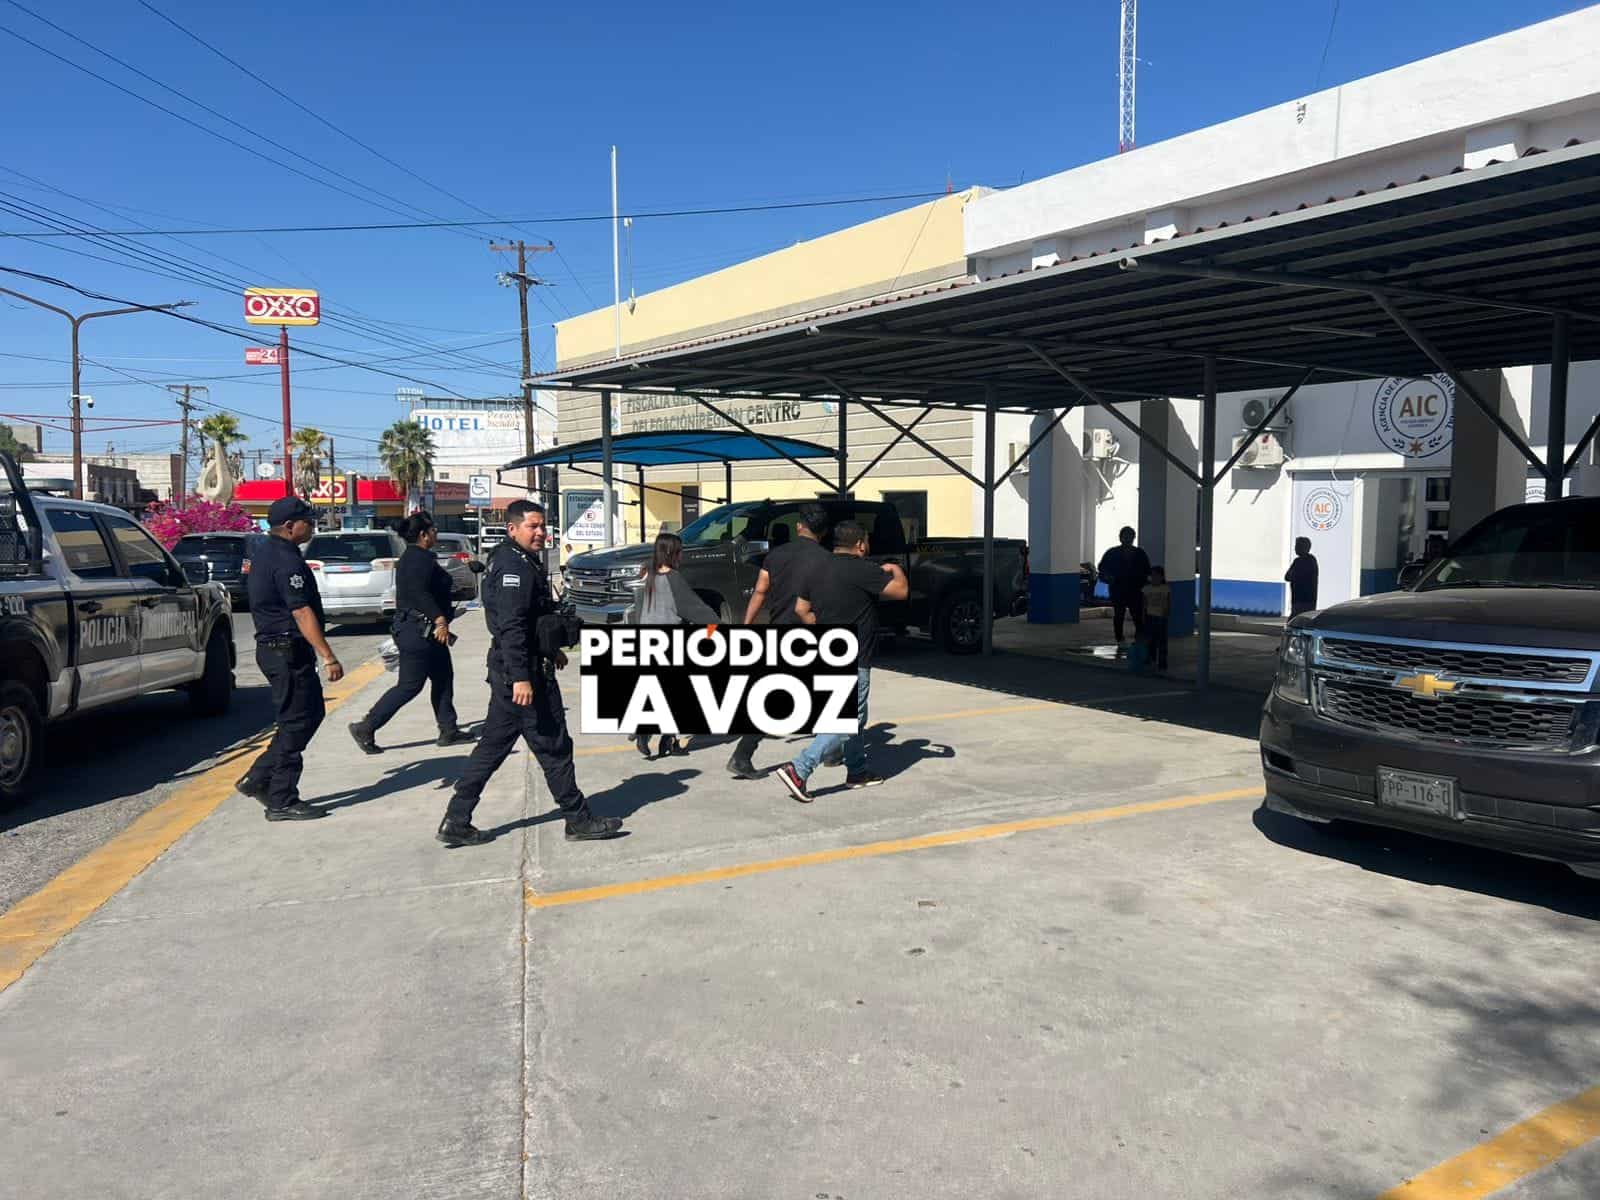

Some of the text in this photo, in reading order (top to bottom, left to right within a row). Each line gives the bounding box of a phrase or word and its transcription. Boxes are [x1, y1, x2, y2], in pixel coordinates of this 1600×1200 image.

[247, 296, 315, 317] OXXO
[747, 401, 800, 424] CENTRO
[1399, 394, 1438, 418] AIC
[417, 415, 484, 430] HOTEL
